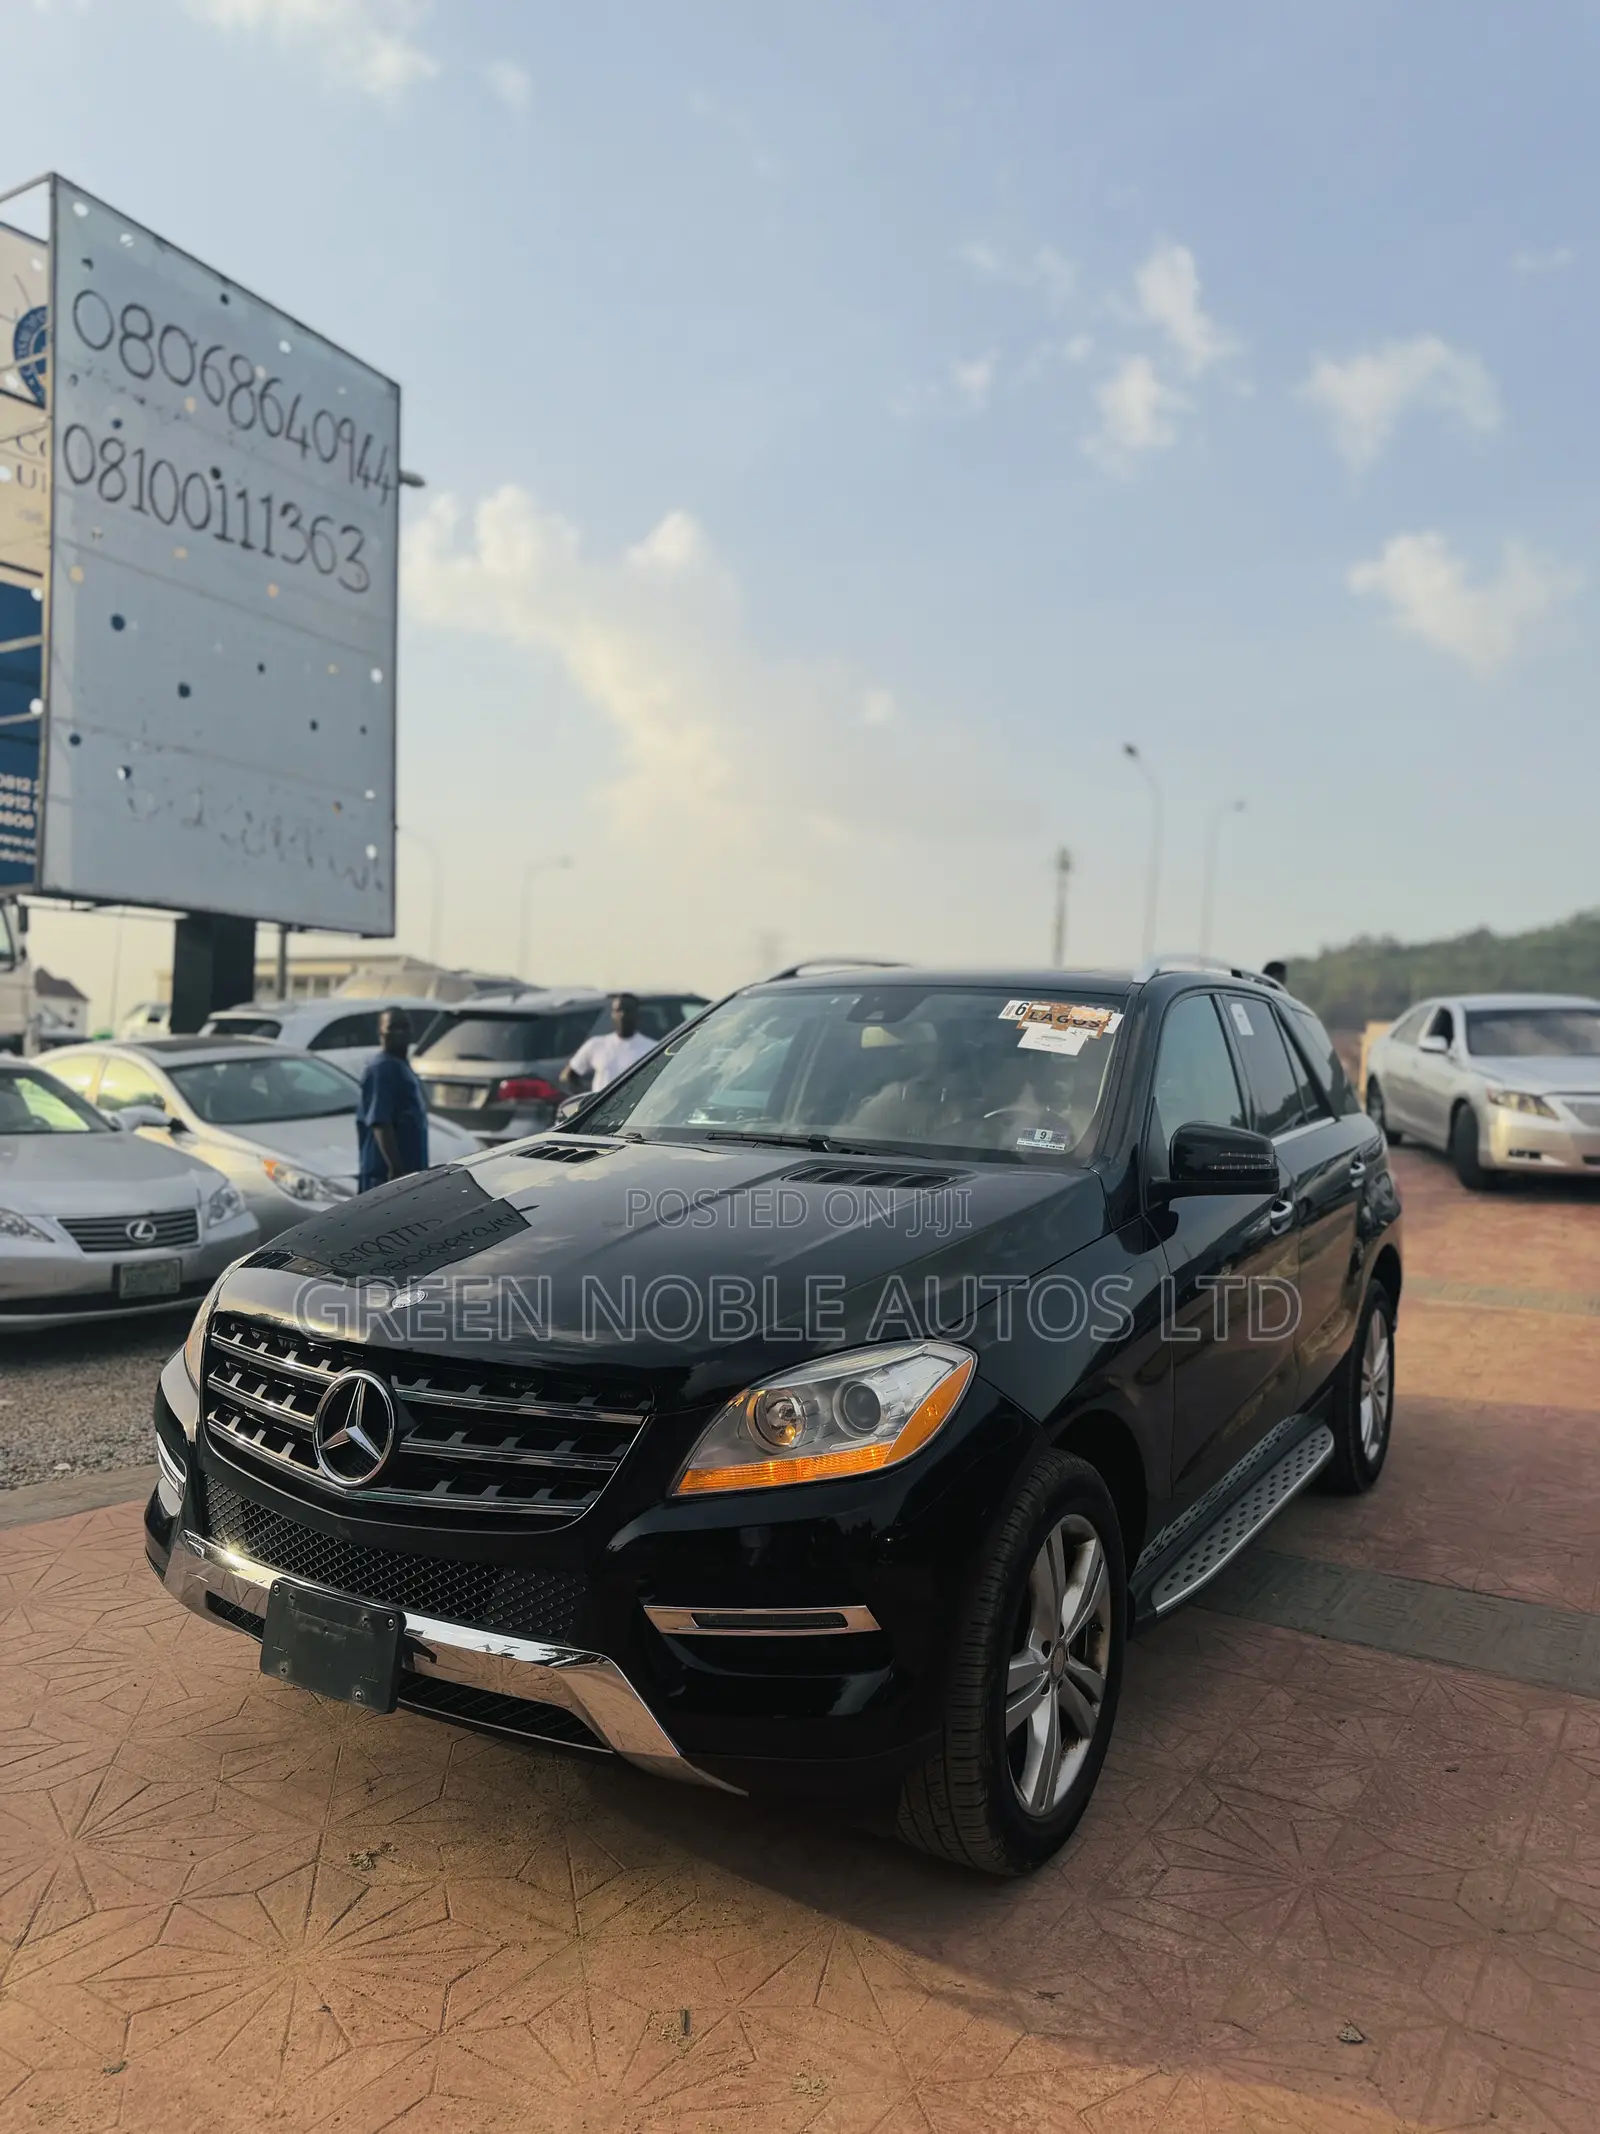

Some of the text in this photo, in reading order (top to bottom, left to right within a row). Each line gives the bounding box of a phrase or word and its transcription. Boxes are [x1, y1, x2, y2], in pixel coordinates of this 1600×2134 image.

[73, 289, 396, 507] 08068640944
[62, 423, 371, 594] 08100111363
[1015, 1002, 1029, 1016] 6
